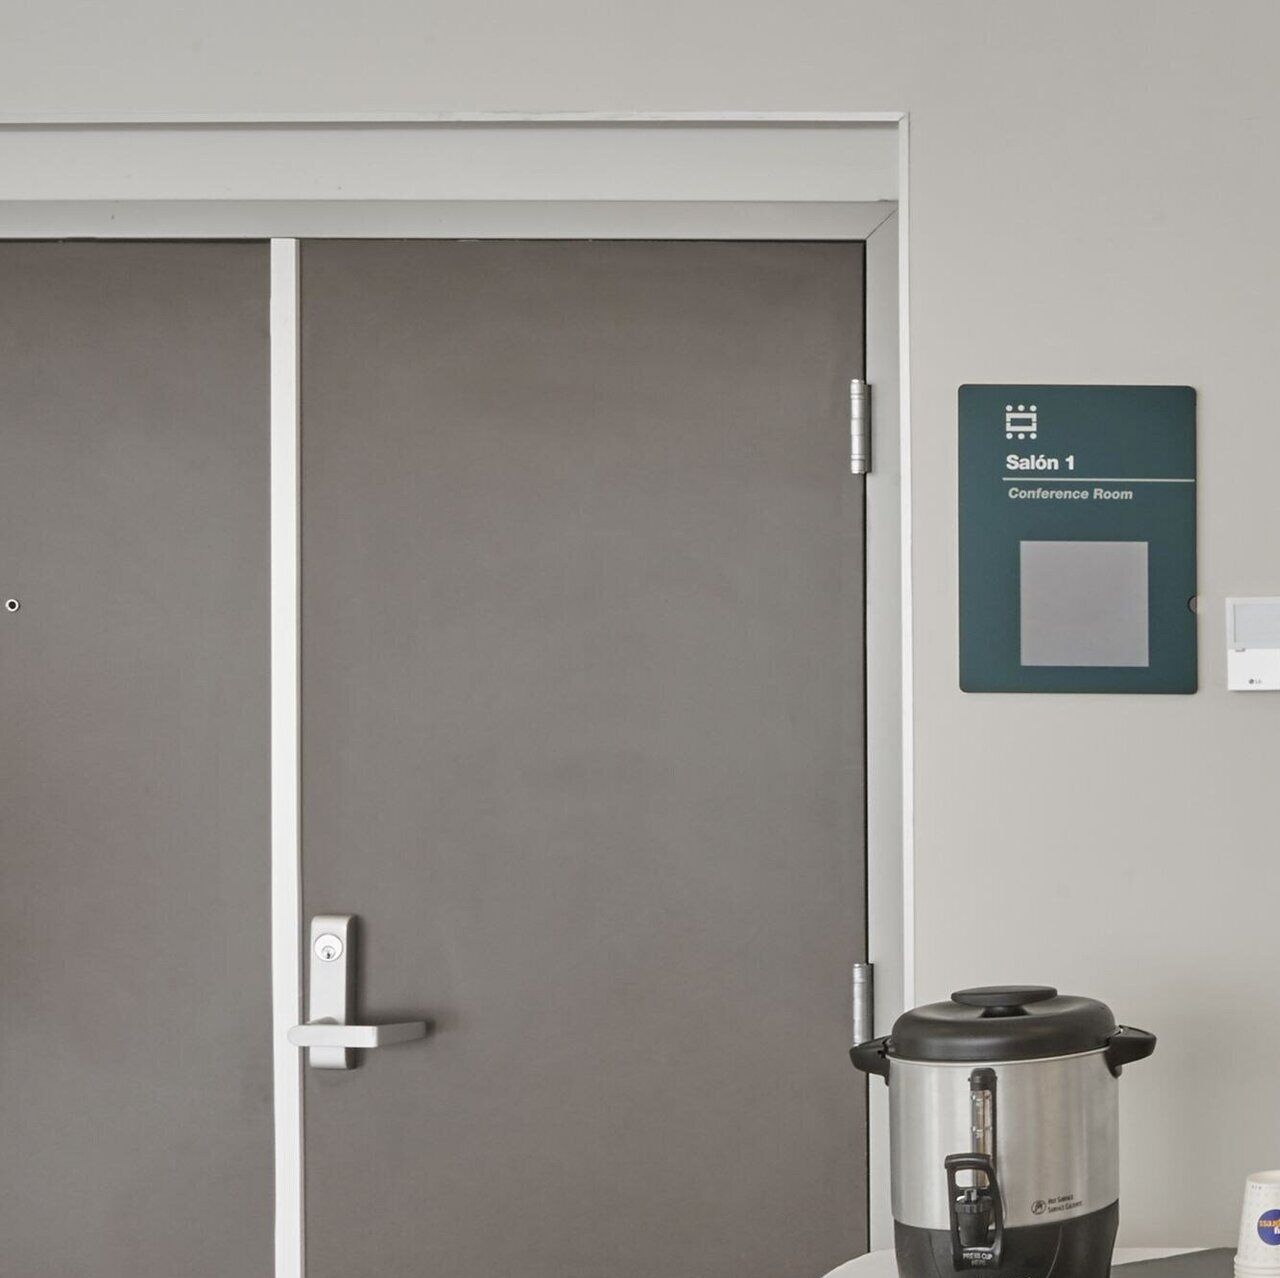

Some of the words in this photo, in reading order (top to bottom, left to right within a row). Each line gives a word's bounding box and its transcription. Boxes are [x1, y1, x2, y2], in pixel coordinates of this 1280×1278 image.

[1006, 454, 1059, 470] Salón
[1065, 455, 1074, 470] 1
[1008, 487, 1089, 500] Conference
[1093, 488, 1133, 500] Room
[981, 1252, 993, 1260] CUP
